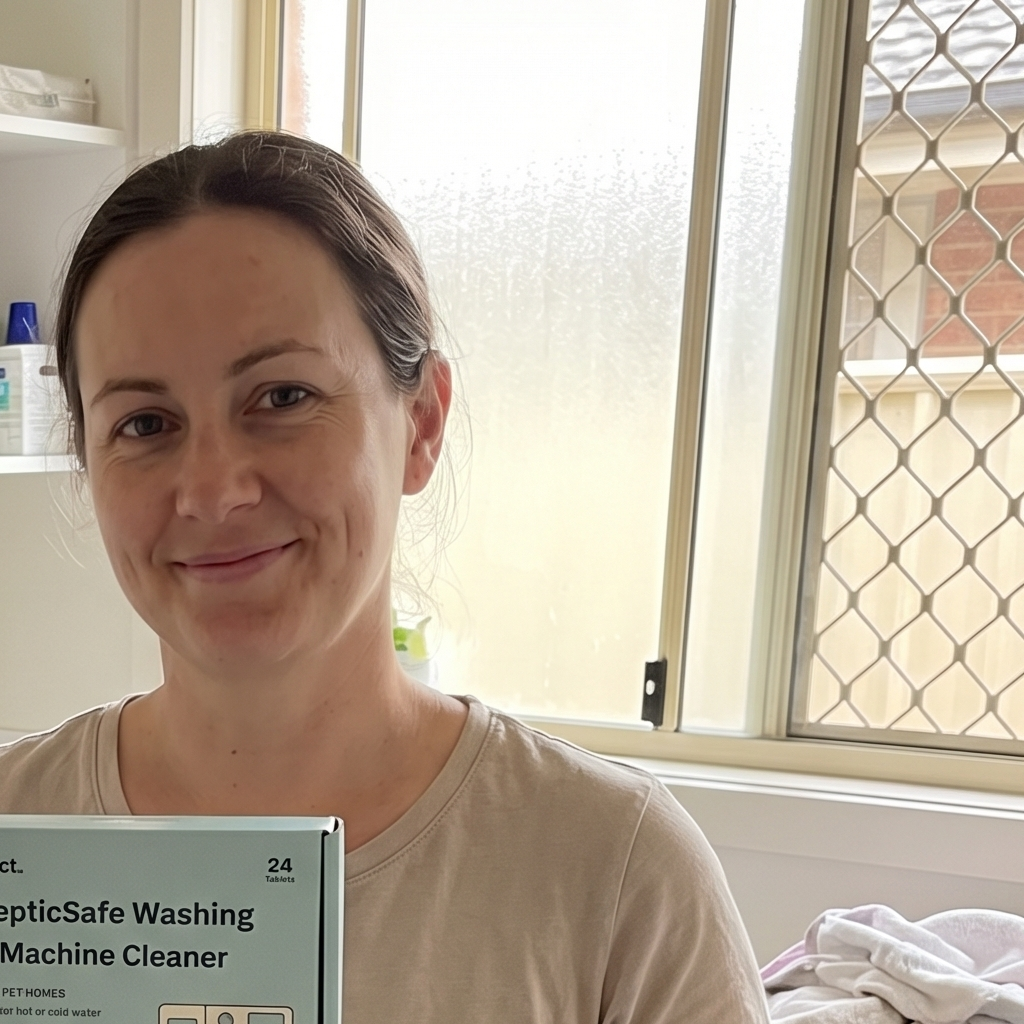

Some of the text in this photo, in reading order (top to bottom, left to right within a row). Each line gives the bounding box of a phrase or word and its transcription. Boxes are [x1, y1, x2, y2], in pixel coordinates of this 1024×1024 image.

[267, 857, 293, 873] 24
[131, 901, 255, 933] Washing
[0, 941, 229, 969] Machine Cleaner
[2, 987, 24, 998] PET
[25, 987, 66, 999] HOMES
[15, 1005, 33, 1017] hot
[34, 1007, 46, 1017] or
[47, 1006, 69, 1017] cold
[71, 1007, 102, 1018] water
